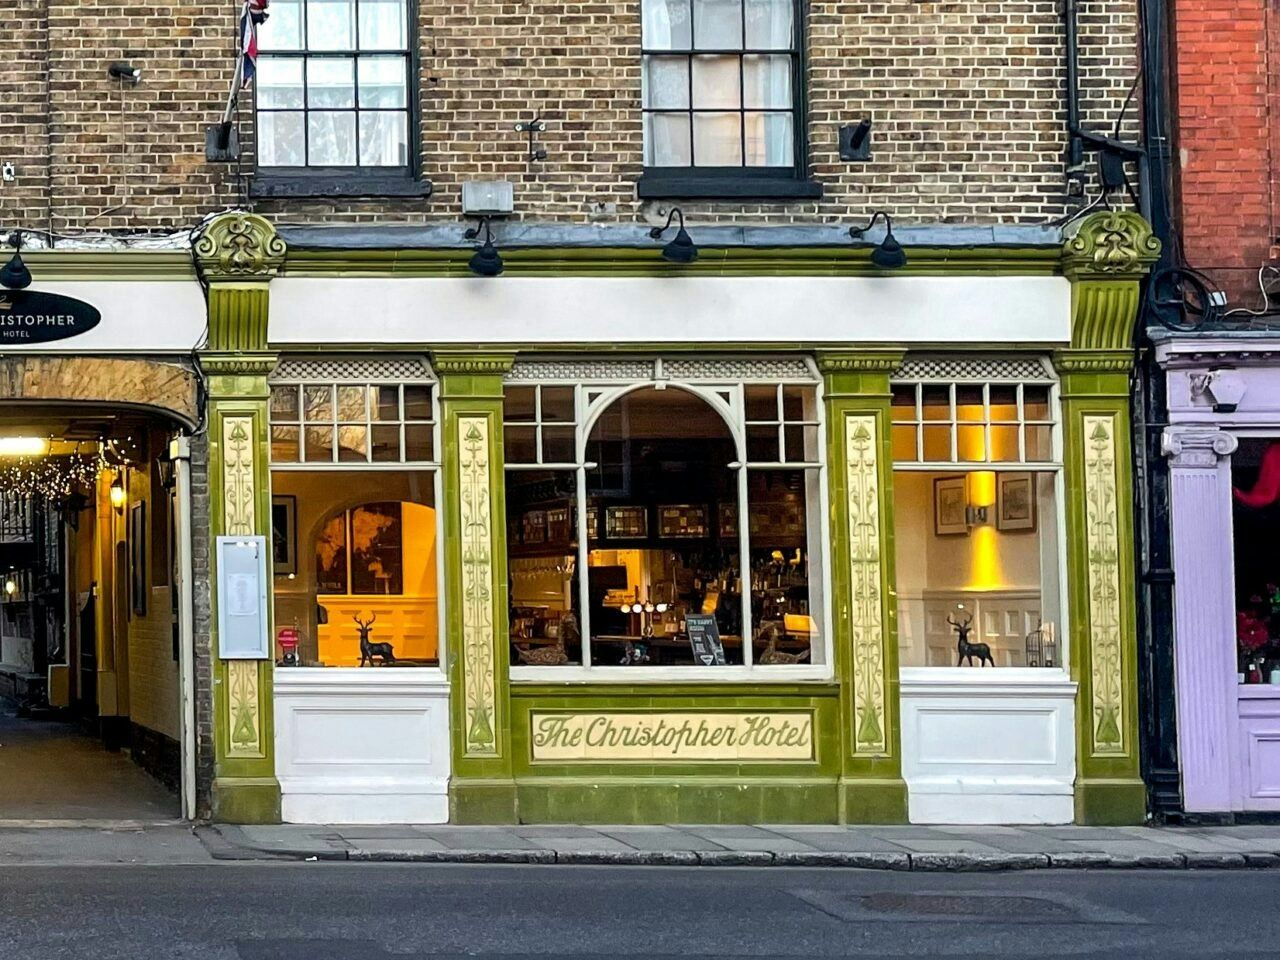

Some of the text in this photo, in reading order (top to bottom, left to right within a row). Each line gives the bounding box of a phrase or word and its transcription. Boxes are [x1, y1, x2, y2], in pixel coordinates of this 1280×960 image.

[3, 330, 30, 338] HOTEL
[534, 715, 810, 754] The Christopher Hotel
